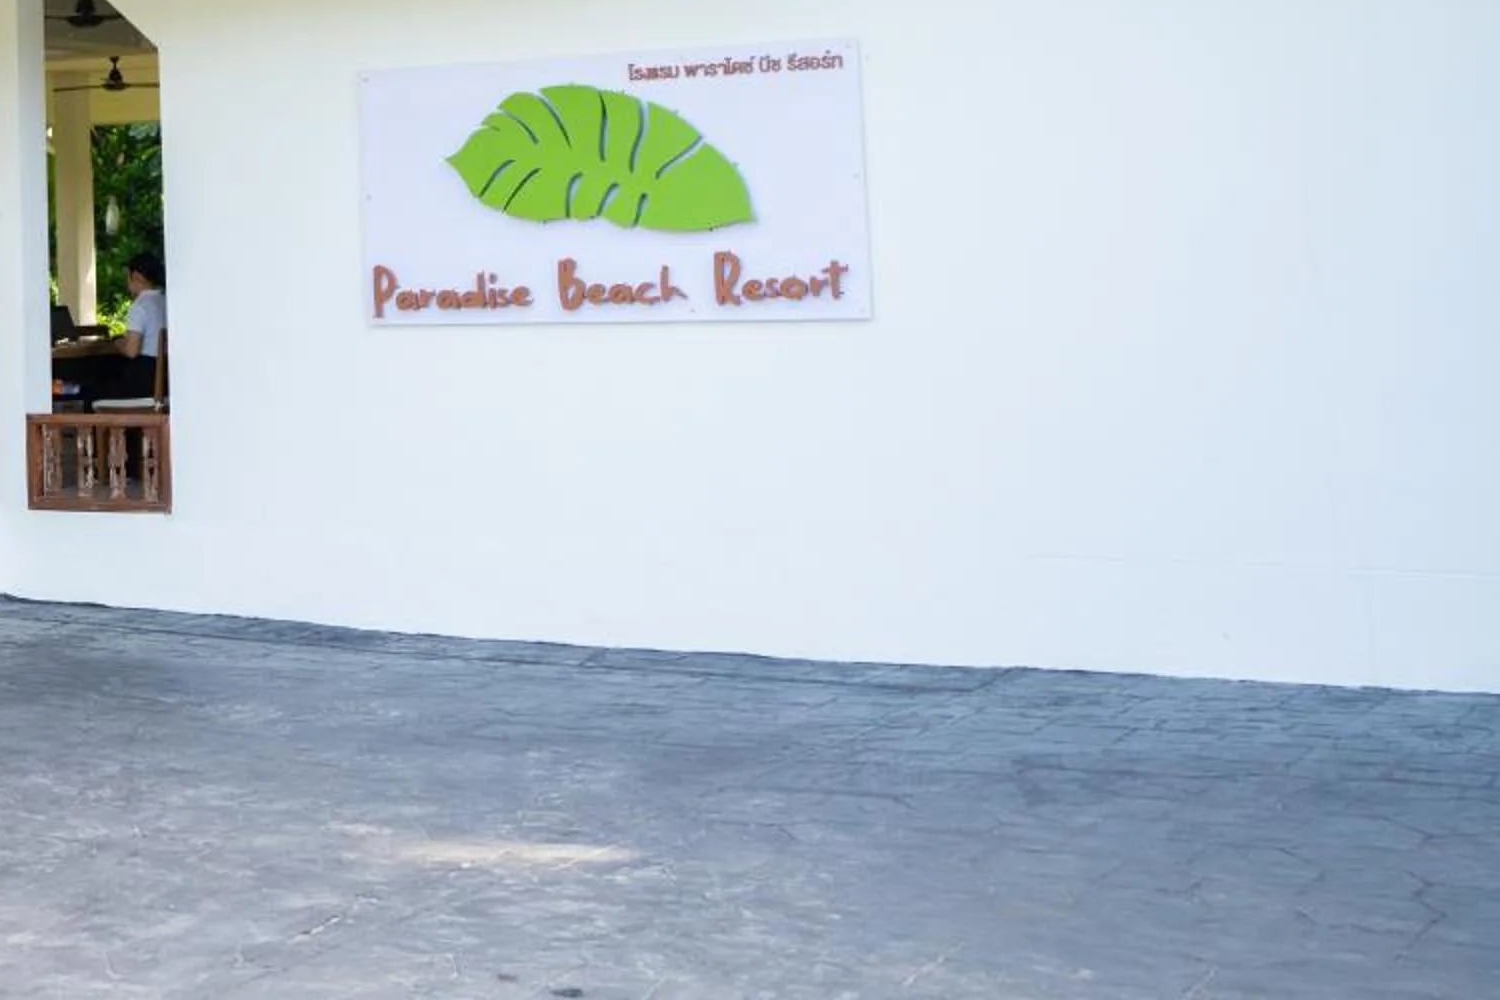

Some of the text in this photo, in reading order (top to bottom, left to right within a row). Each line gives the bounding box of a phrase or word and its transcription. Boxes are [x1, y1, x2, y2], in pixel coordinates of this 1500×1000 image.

[628, 63, 680, 81] โรงแรม
[372, 249, 849, 319] Paradise Beach Resort
